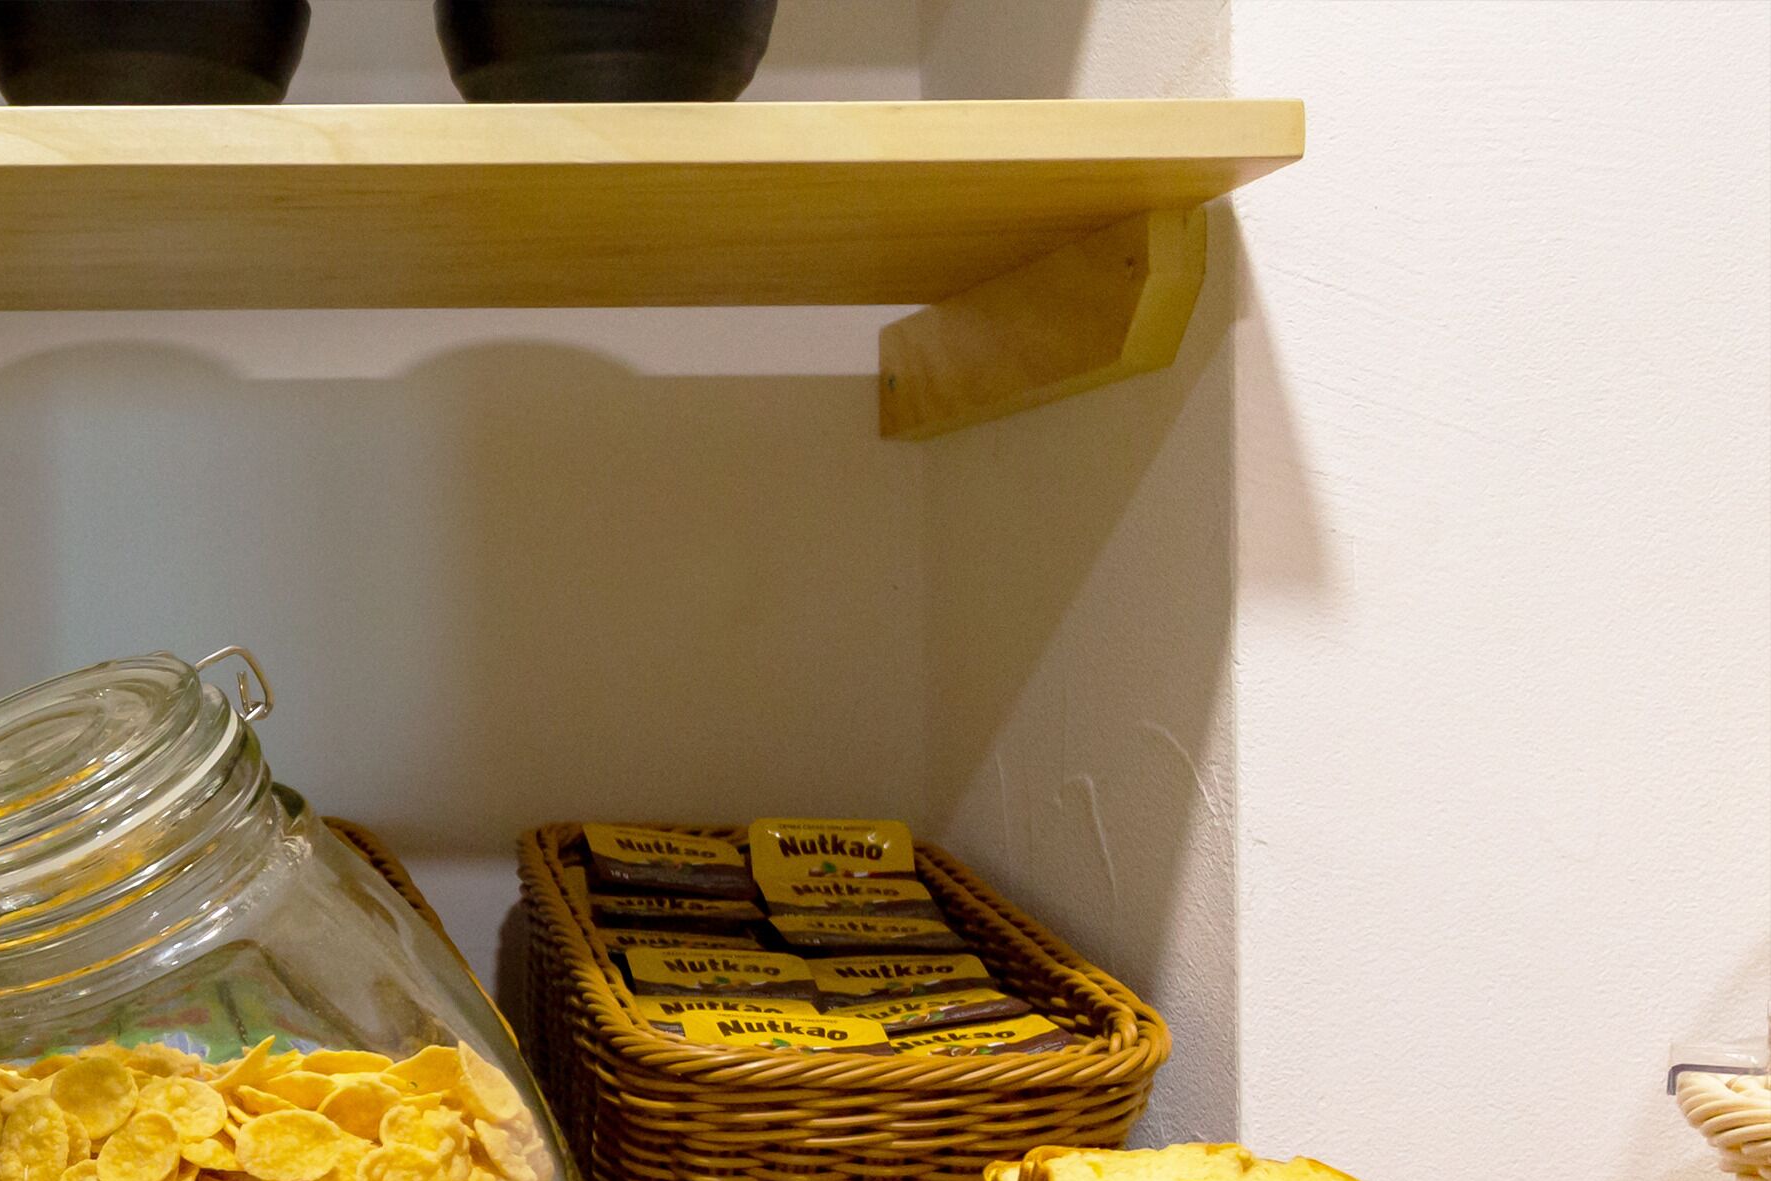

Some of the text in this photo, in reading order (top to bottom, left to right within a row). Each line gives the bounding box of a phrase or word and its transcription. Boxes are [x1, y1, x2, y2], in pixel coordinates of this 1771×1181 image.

[615, 838, 717, 859] Nutkao
[779, 834, 884, 861] Nutkao
[663, 958, 781, 976] Nutkao
[834, 963, 954, 979] Nutkao
[716, 1019, 848, 1042] Nutkao
